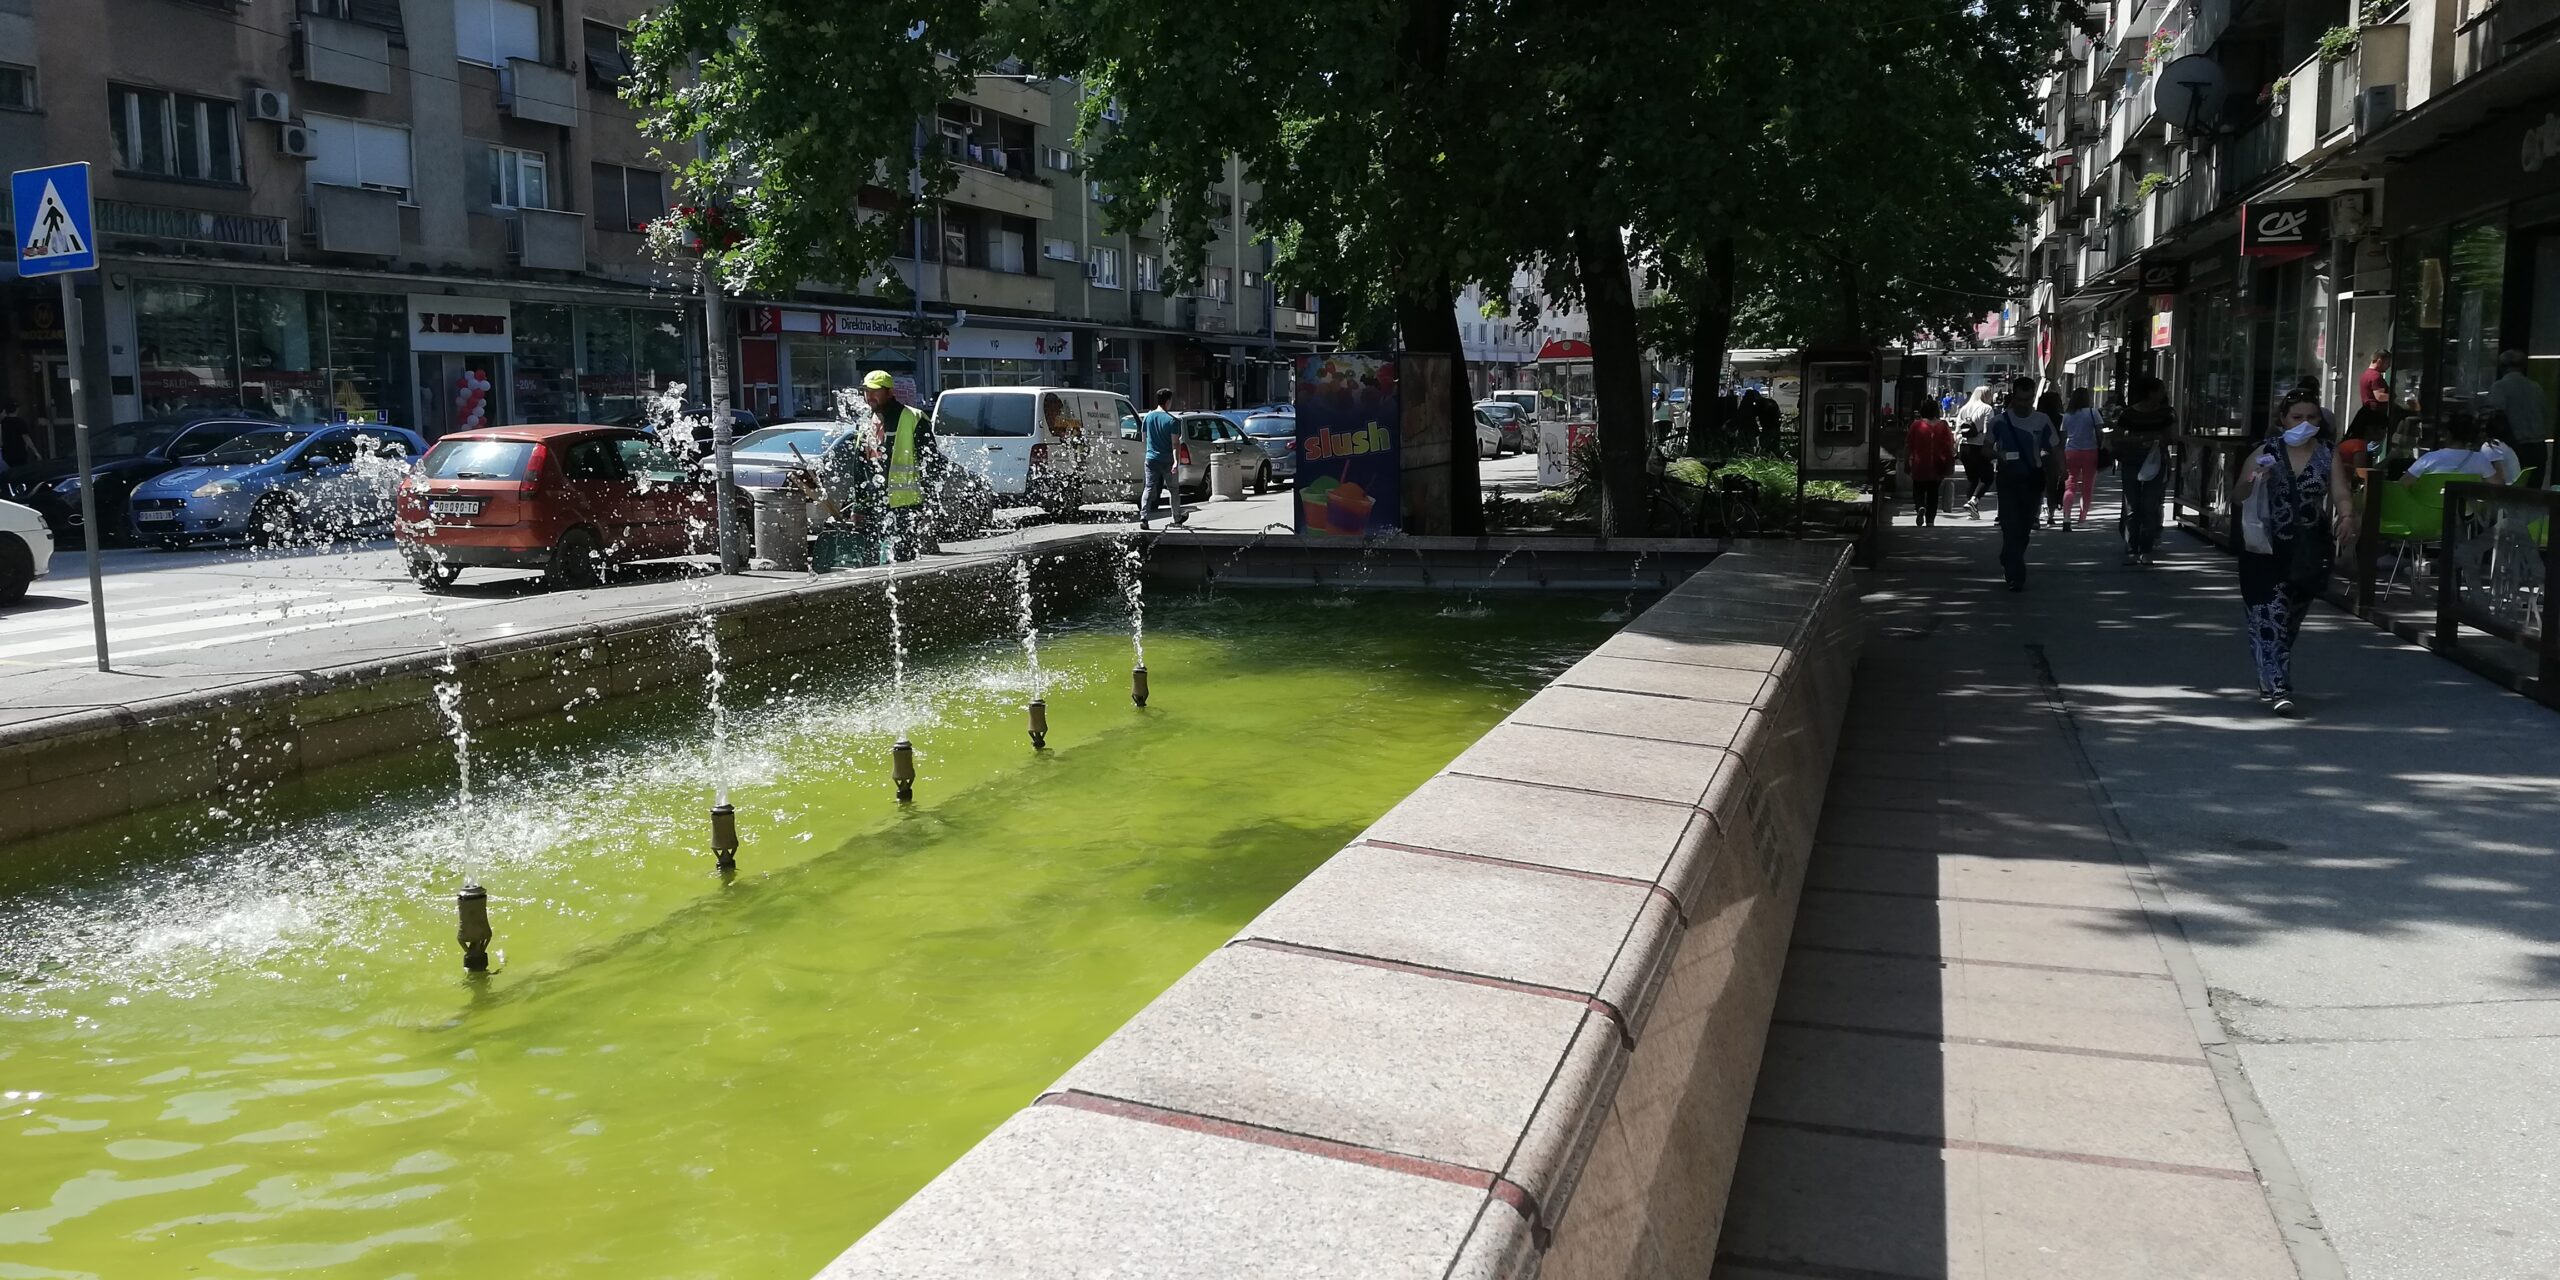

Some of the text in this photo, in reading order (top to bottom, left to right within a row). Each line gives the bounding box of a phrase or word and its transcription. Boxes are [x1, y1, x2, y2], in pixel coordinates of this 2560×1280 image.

[841, 317, 892, 332] Direktna Banka
[1048, 342, 1064, 355] vip
[1303, 420, 1392, 461] slush
